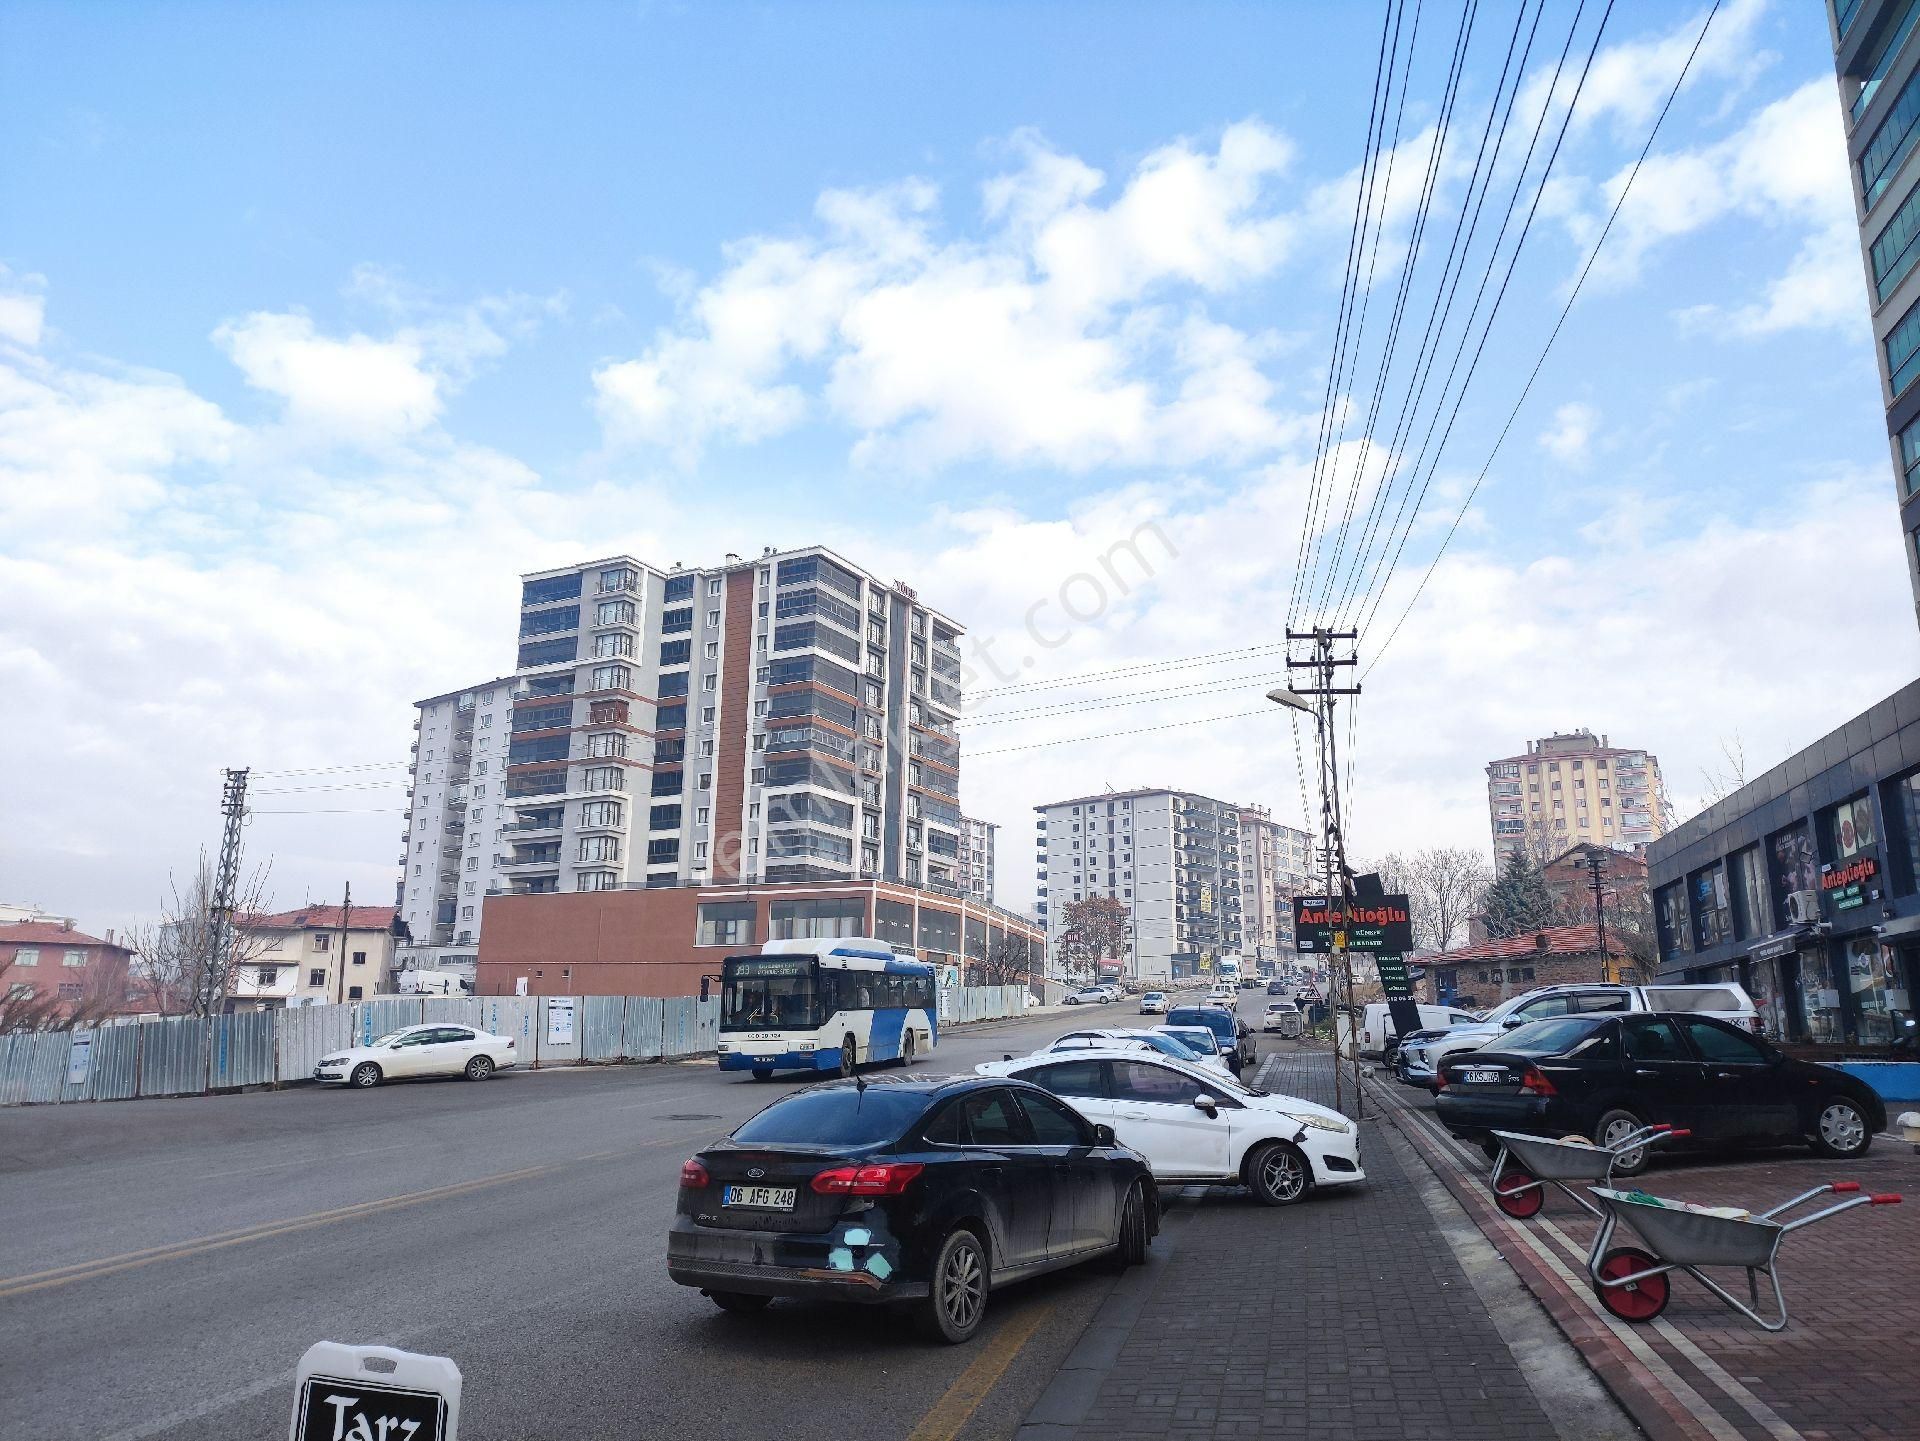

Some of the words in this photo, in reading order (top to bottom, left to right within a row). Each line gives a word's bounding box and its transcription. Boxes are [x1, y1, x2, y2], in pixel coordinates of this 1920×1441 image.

[730, 1187, 743, 1203] 06
[749, 1188, 770, 1205] AFG
[774, 1190, 794, 1206] 248
[323, 1394, 423, 1441] Tarz
